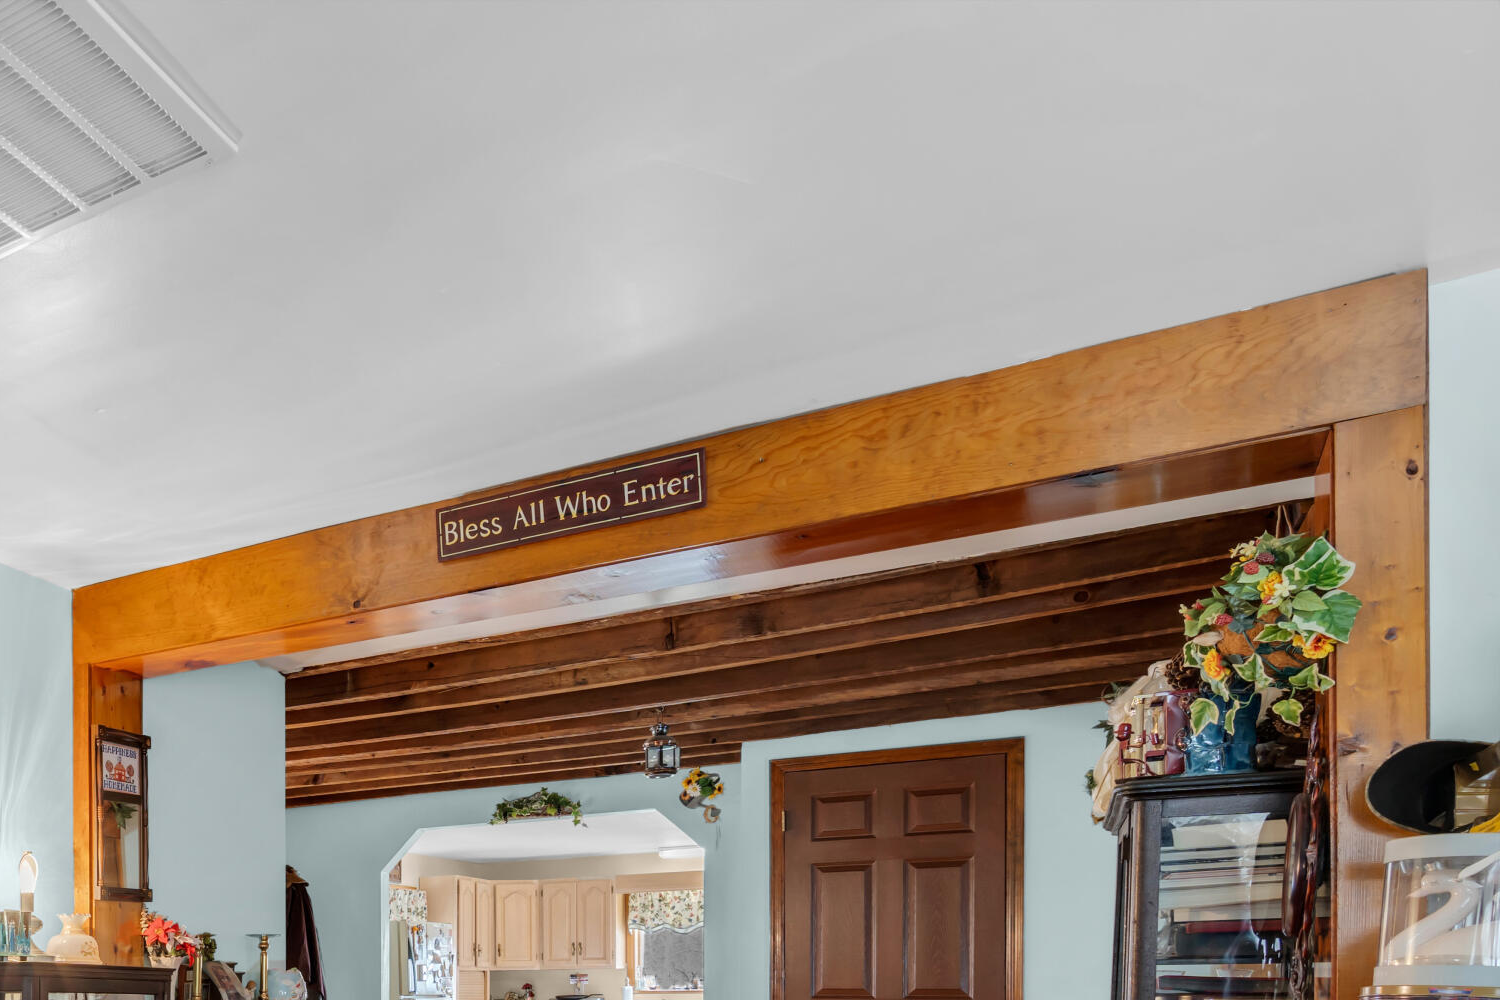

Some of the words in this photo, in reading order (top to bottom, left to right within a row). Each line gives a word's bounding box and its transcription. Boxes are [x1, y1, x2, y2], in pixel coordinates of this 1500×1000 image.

[444, 514, 503, 546] Bless
[513, 499, 545, 531] All
[554, 490, 611, 522] Who
[622, 473, 695, 507] Enter
[102, 744, 137, 759] HAPPINESS
[103, 780, 137, 793] HOMEMADE
